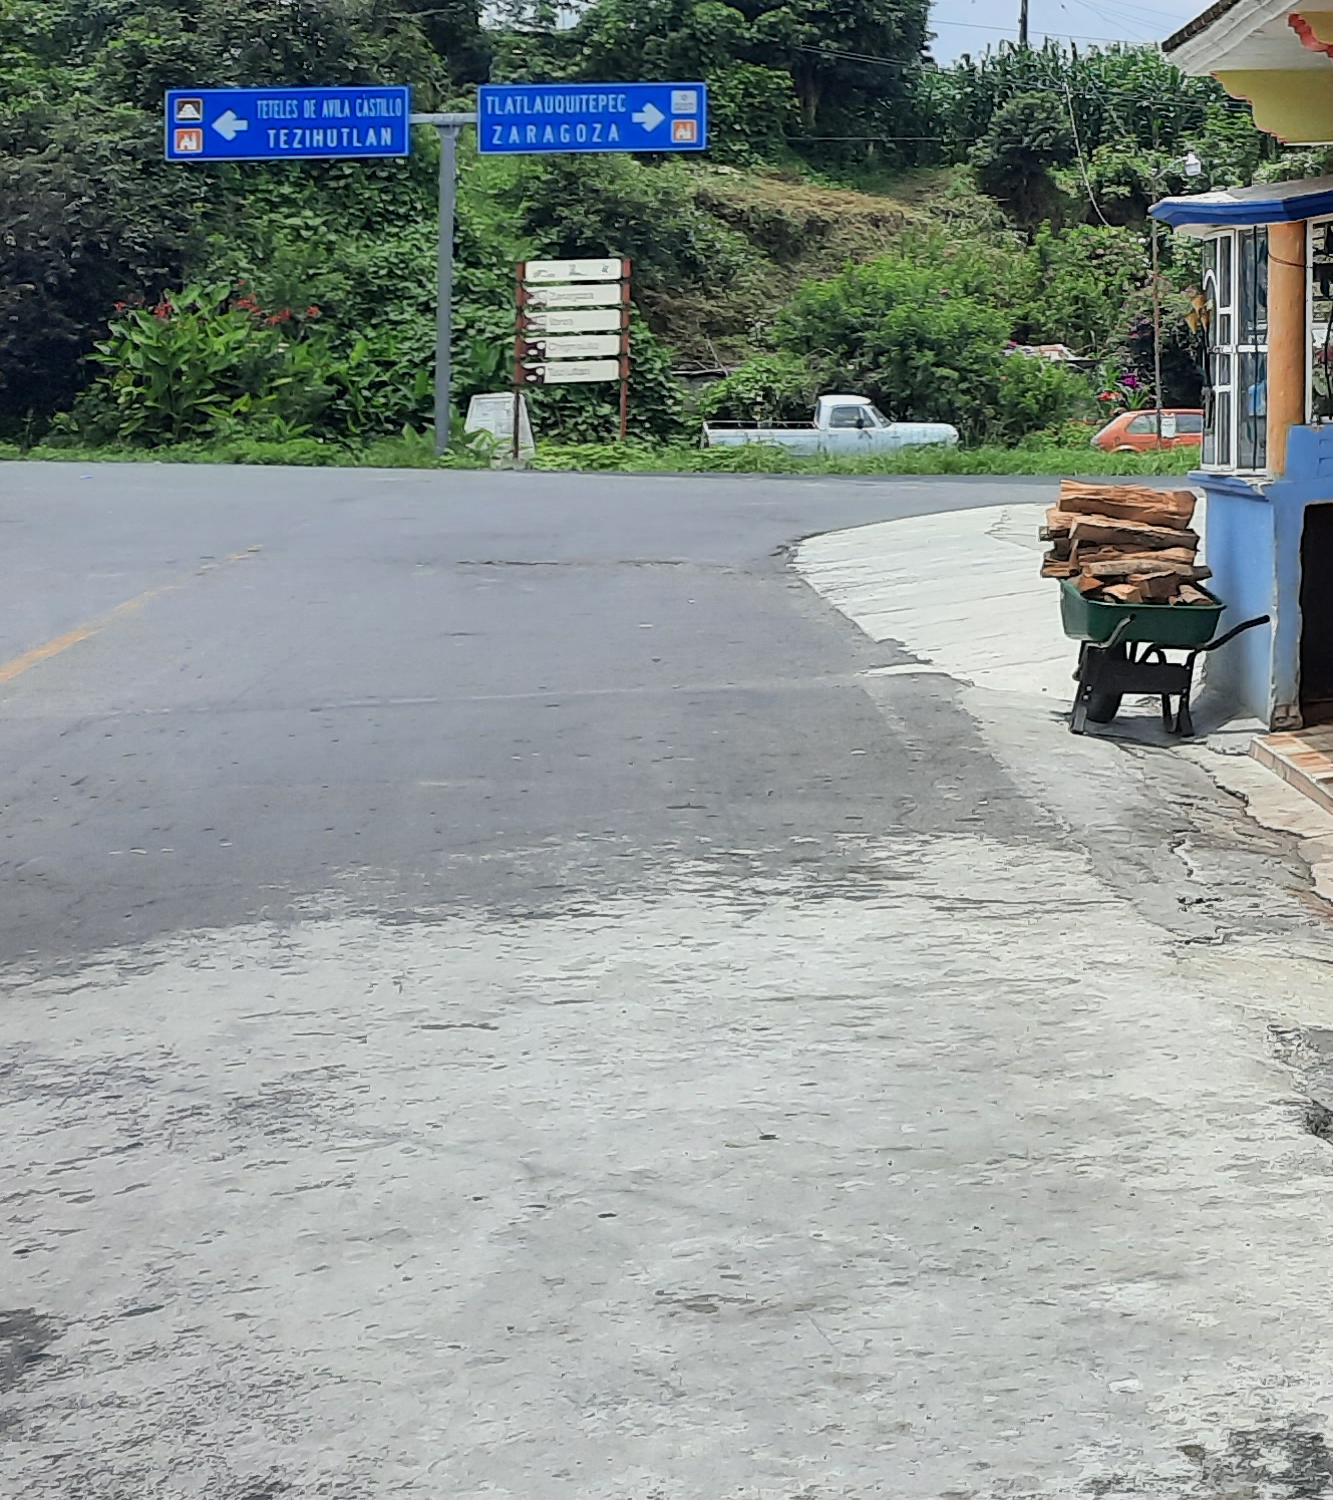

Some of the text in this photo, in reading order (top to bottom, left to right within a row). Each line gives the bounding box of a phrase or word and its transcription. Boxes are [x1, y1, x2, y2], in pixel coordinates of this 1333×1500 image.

[257, 99, 299, 119] TETELES
[303, 99, 317, 119] DE
[322, 98, 350, 118] AVILA
[486, 94, 627, 115] TLATLAUQUITEPEC
[268, 127, 392, 149] TEZIHUTLAN
[492, 123, 620, 145] ZARAGOZA
